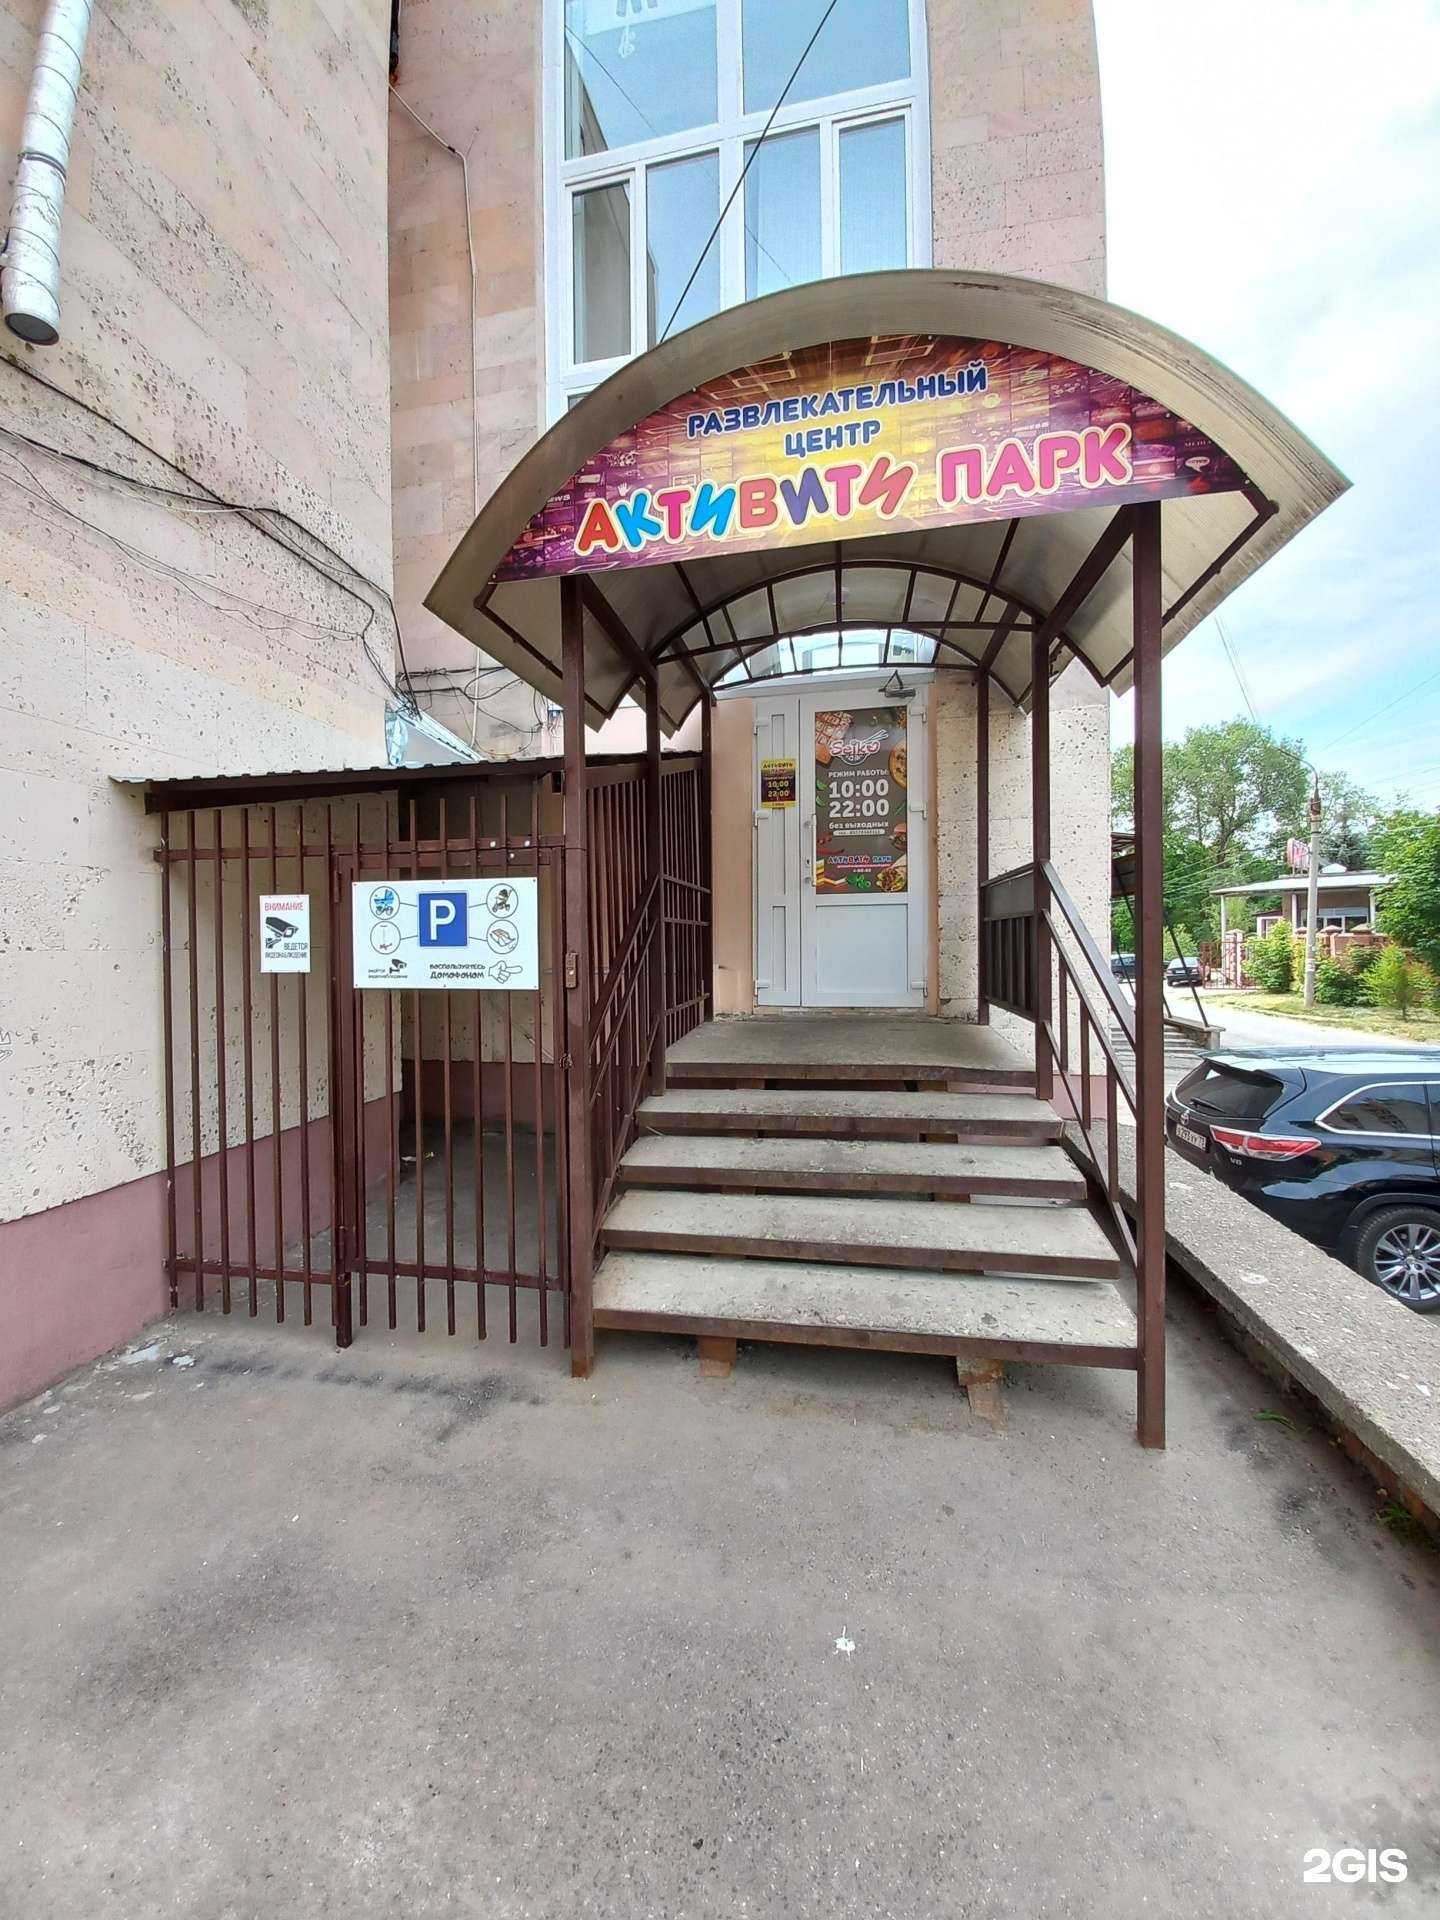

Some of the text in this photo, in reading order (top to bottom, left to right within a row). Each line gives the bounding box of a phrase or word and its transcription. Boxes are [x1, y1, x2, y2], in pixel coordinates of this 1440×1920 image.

[688, 361, 987, 438] РАЗВЛЕКАТЕЛЬНЫЙ
[784, 420, 881, 458] ЦЕНТР
[575, 423, 1132, 555] АКТИВИТИ ПАРК
[828, 770, 855, 778] РЕЖИМ
[828, 778, 889, 798] 10:00
[829, 799, 890, 818] 22:00
[829, 820, 889, 829] без выходных
[264, 902, 304, 912] ВНИМАНИЕ
